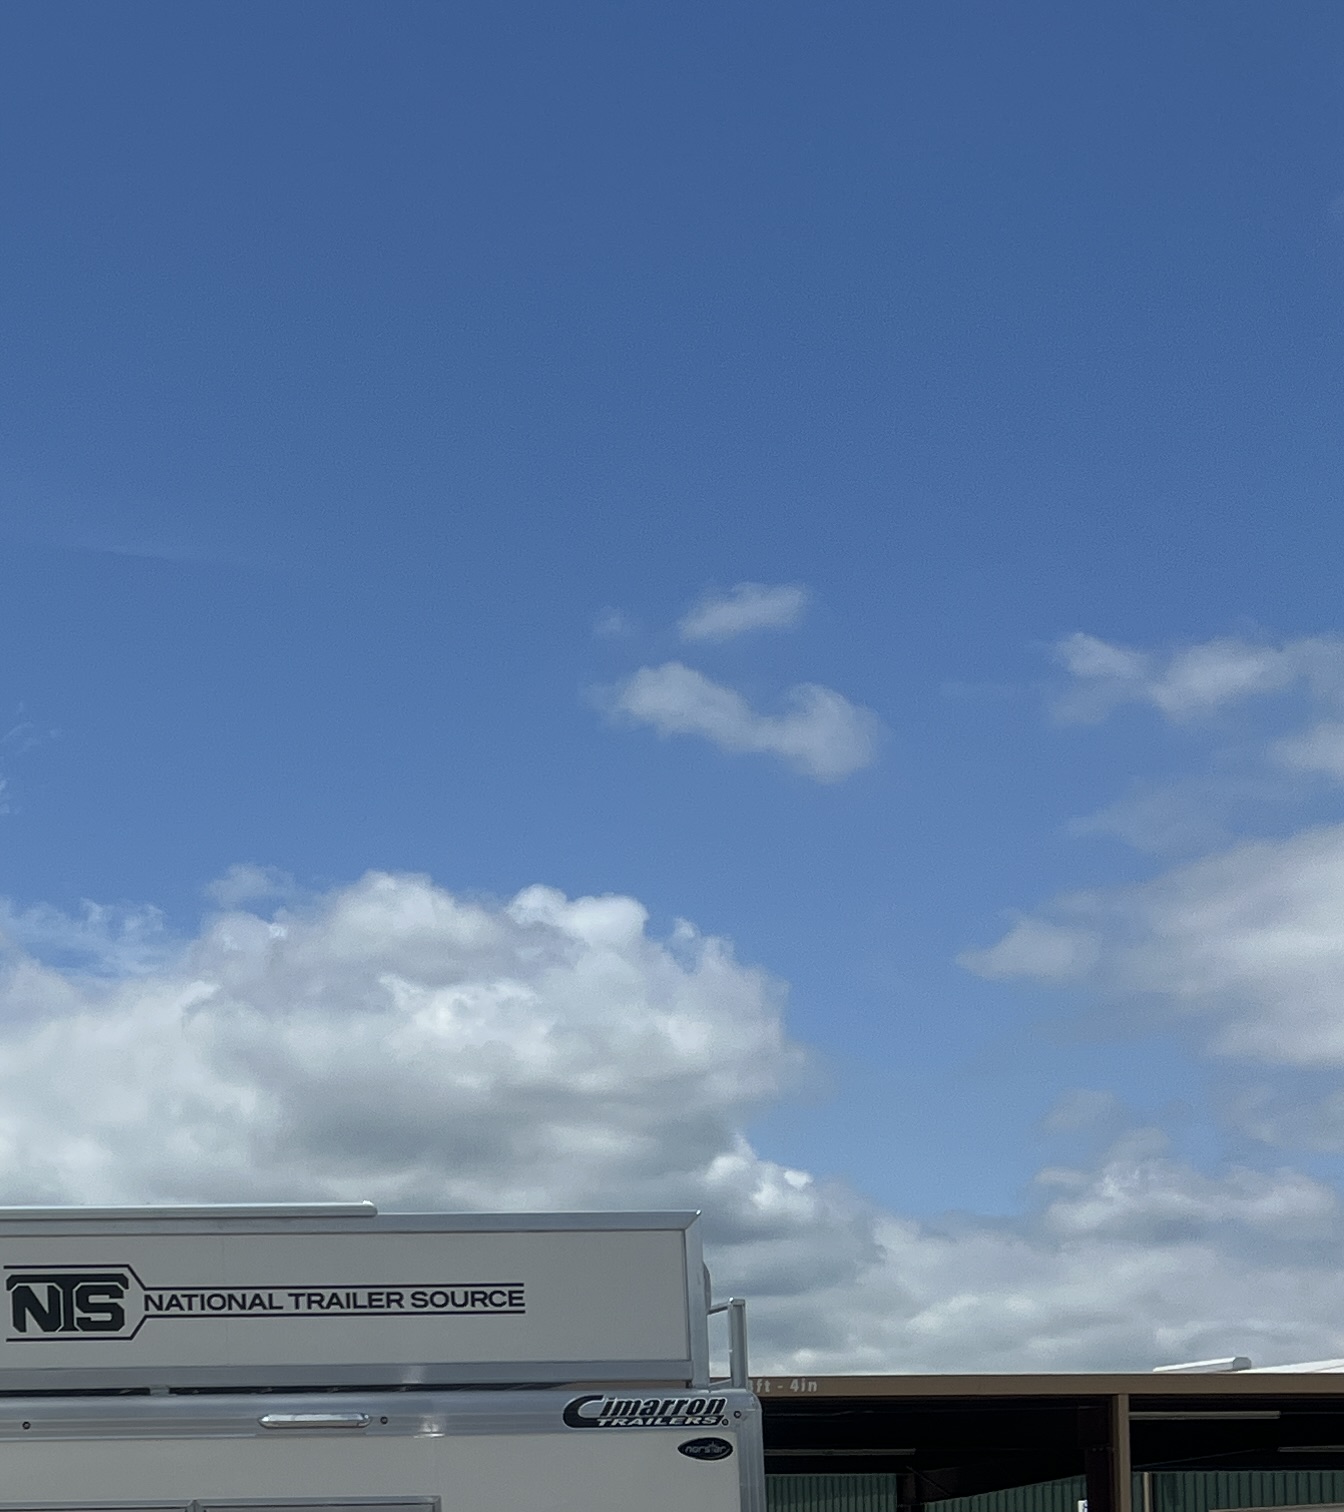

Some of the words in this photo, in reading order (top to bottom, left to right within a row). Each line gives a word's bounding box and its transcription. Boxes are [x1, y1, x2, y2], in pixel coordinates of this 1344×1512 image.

[6, 1273, 130, 1333] NTS
[144, 1293, 284, 1312] NATIONAL
[287, 1291, 405, 1310] TRAILER
[411, 1290, 526, 1309] SOURCE
[563, 1394, 727, 1427] Cimarron
[596, 1416, 719, 1427] TRAILERS
